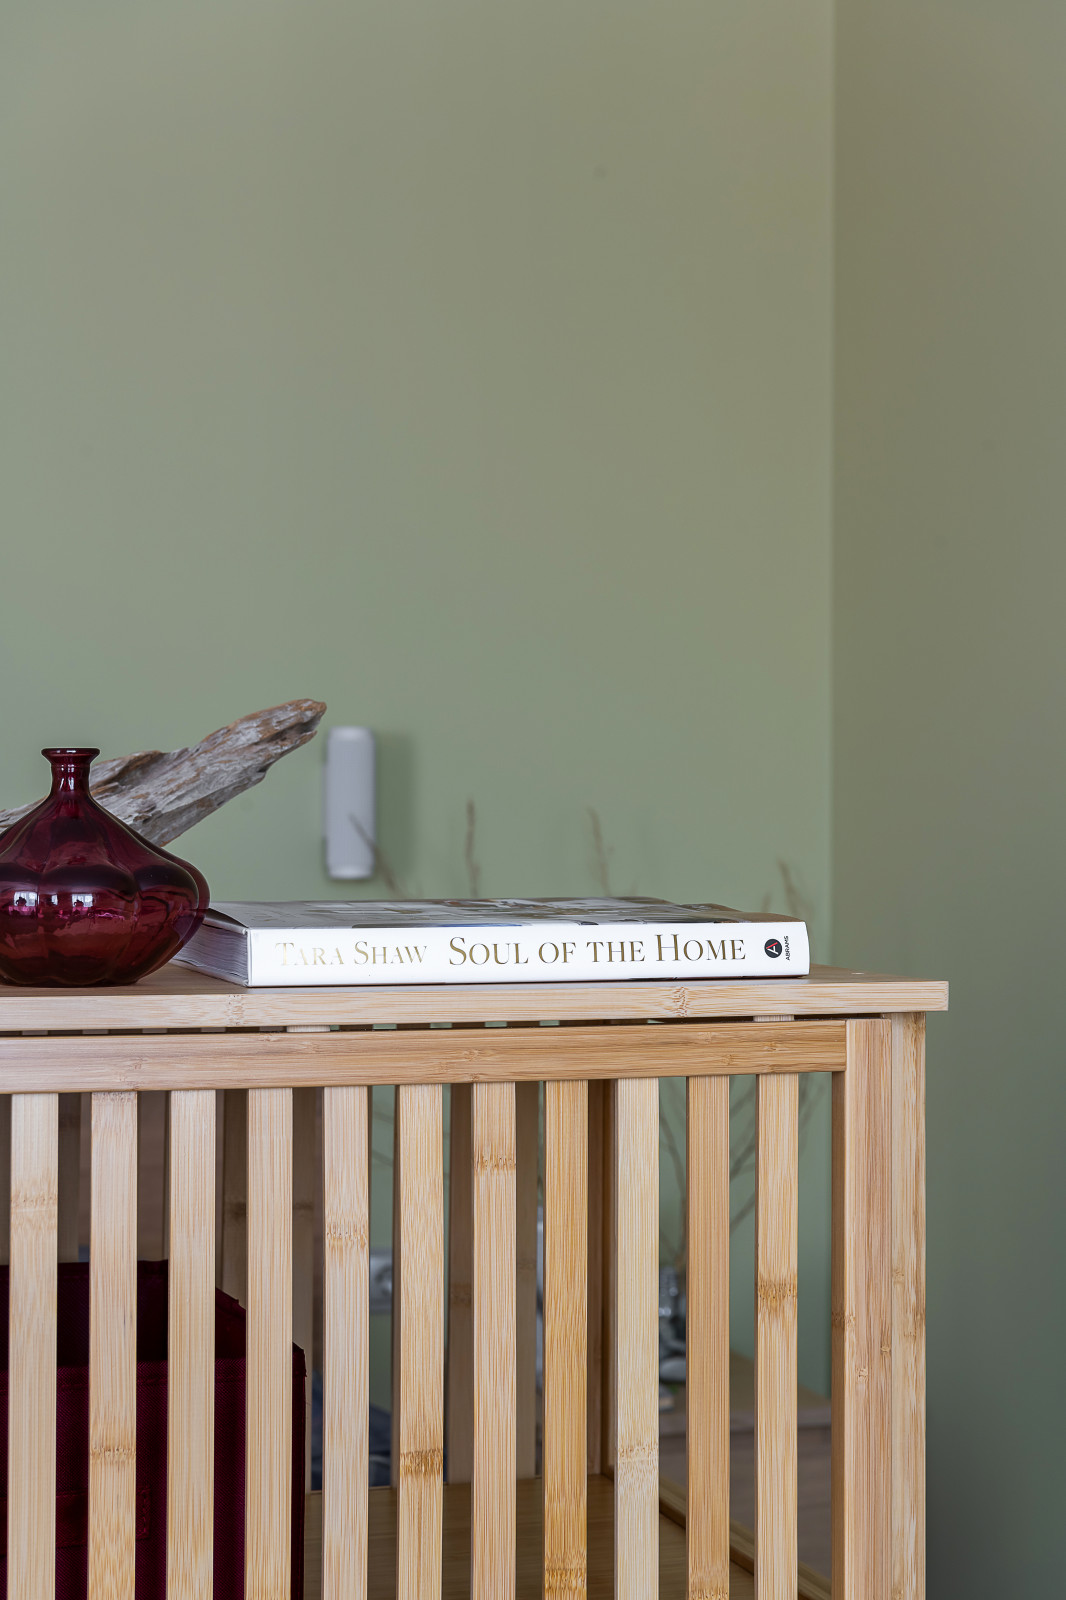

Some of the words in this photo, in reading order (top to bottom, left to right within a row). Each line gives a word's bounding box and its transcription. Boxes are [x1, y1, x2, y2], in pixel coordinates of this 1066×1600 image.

[275, 942, 345, 966] TARA
[353, 940, 427, 965] SHAW
[449, 936, 529, 966] SOUL
[538, 941, 576, 964] OF
[586, 940, 646, 963] THE
[655, 933, 747, 962] HOME
[783, 935, 791, 961] ABRAMS
